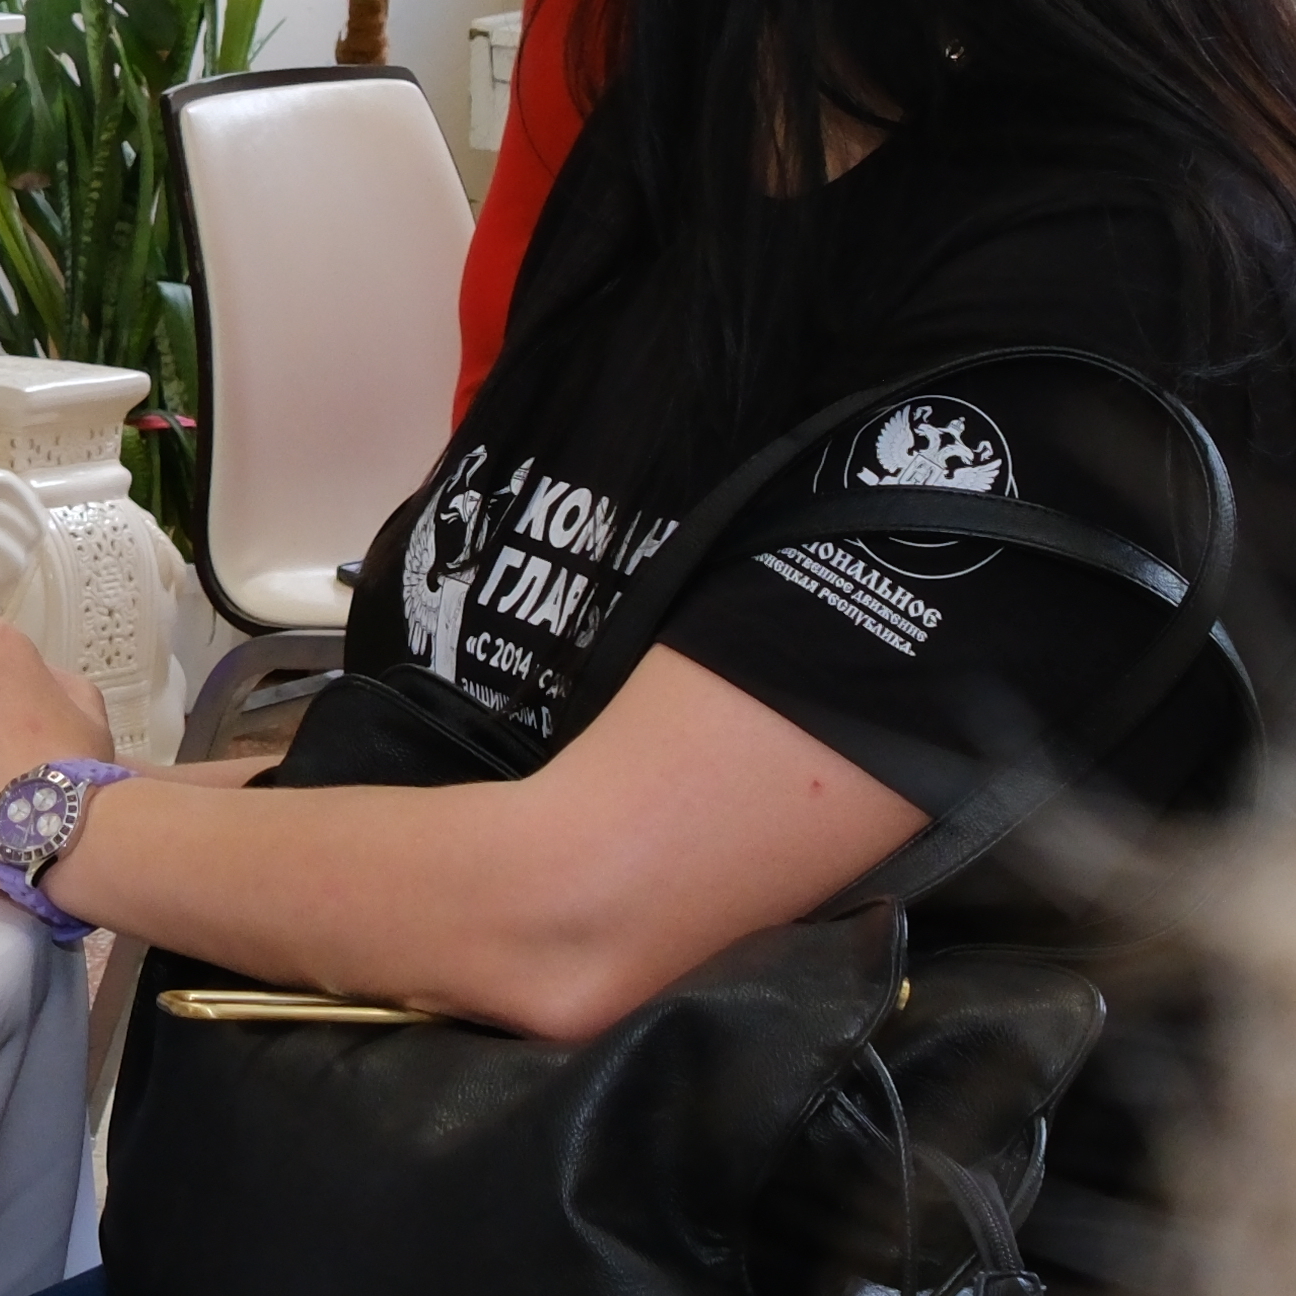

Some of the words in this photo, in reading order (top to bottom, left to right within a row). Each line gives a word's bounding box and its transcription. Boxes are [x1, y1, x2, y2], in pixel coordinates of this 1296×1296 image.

[817, 586, 917, 657] РЕСПУБЛИКА
[850, 589, 929, 643] ДВИЖЕНИЕ
[489, 637, 533, 681] 2014
